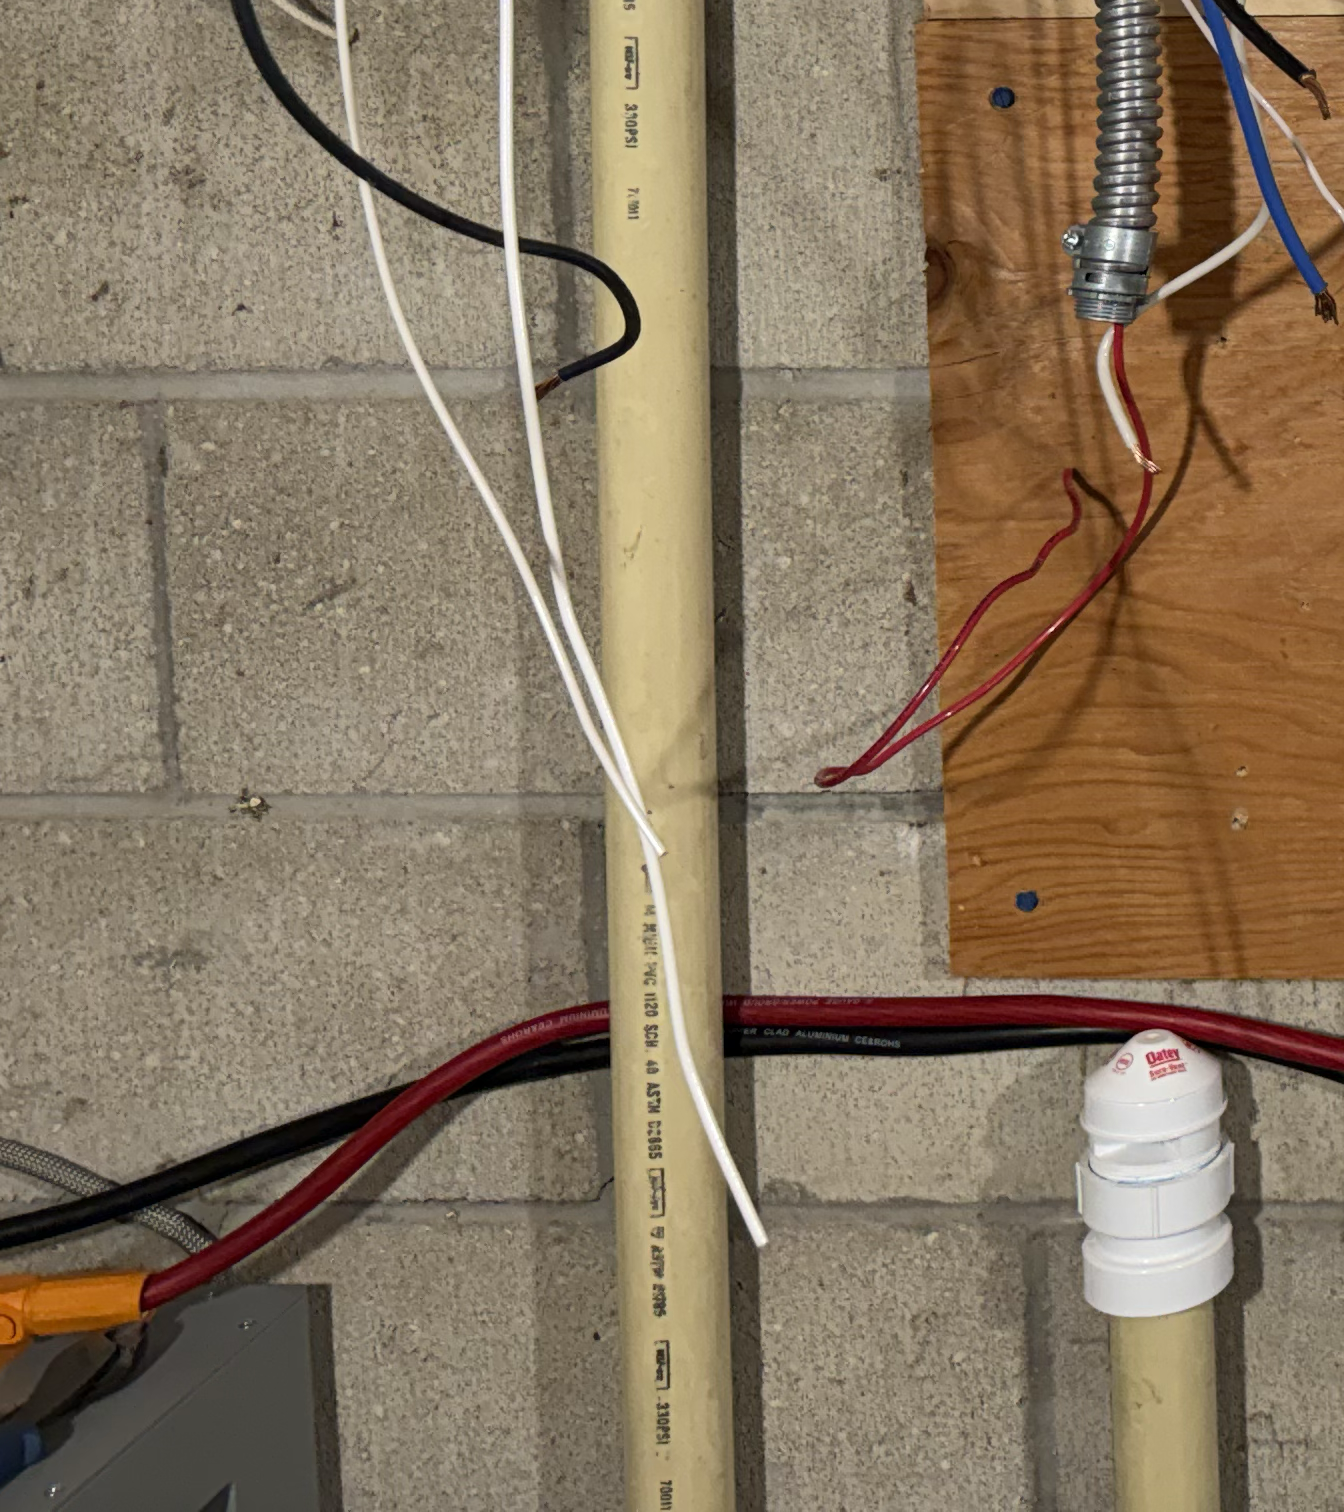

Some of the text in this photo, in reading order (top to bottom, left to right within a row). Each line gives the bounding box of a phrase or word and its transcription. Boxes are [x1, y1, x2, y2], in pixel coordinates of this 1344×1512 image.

[764, 1028, 790, 1036] CLAD
[795, 1030, 850, 1043] ALUMINIUM
[1145, 1048, 1180, 1065] Oatey
